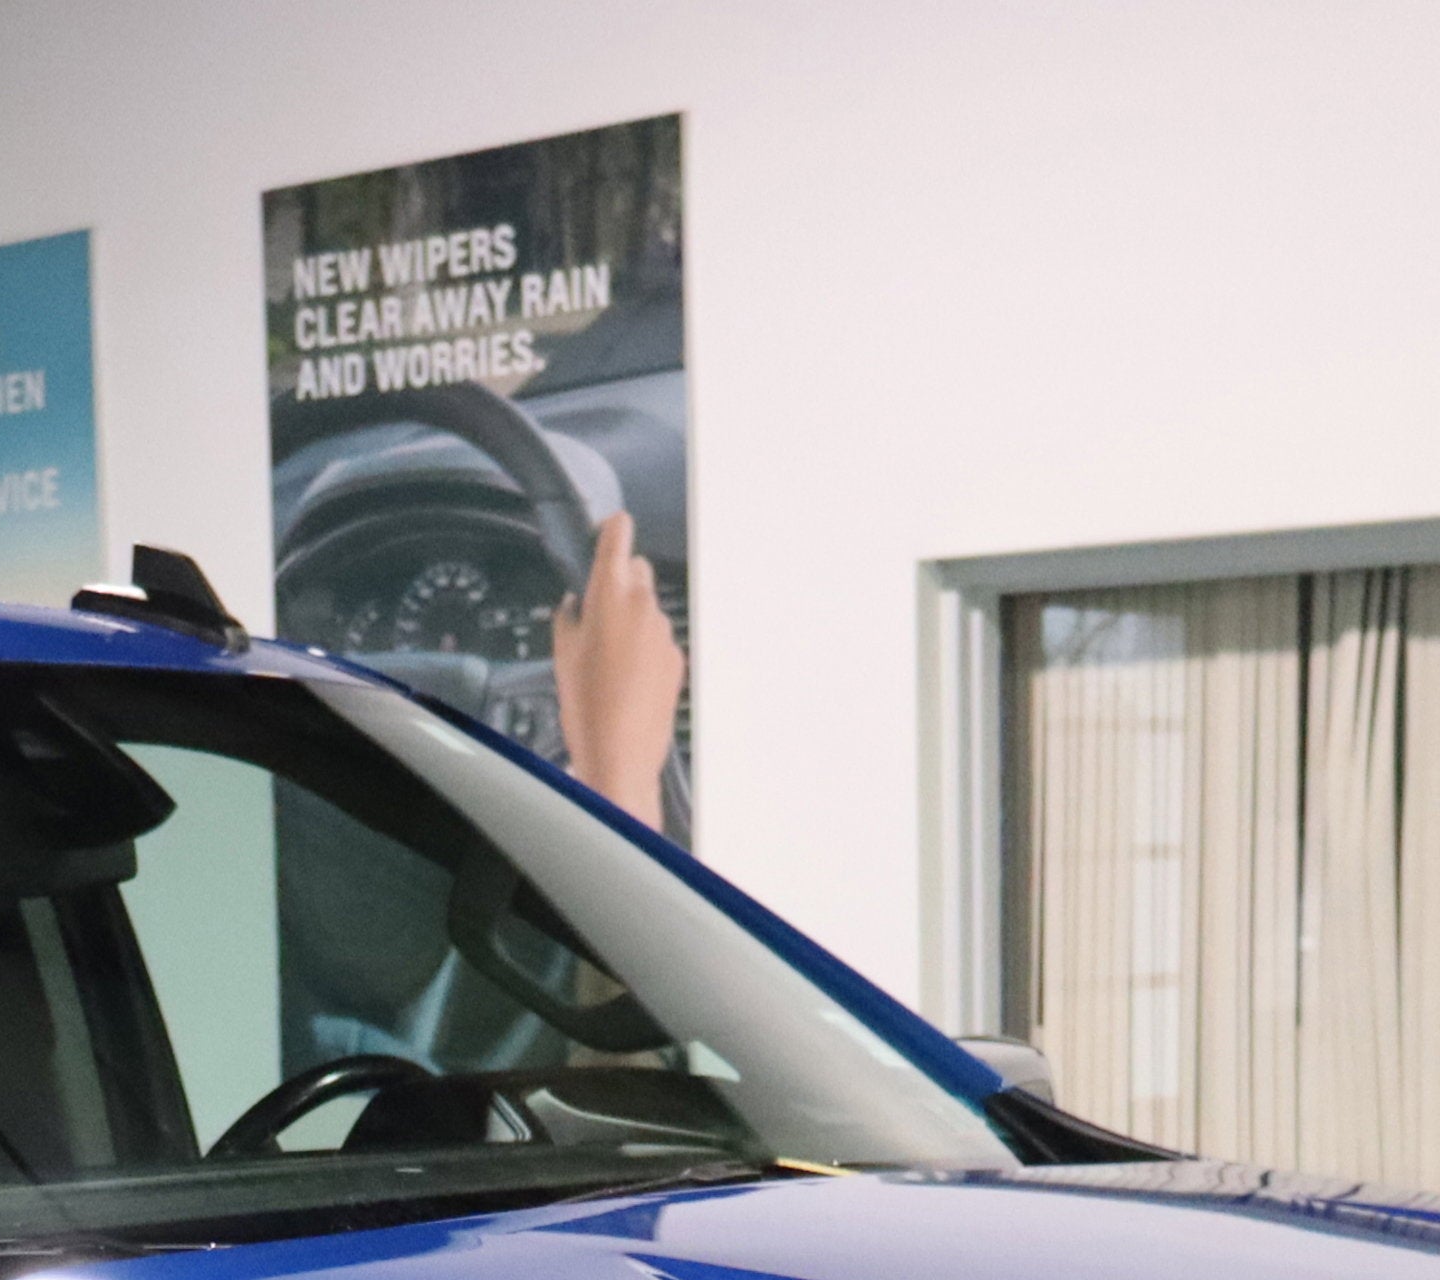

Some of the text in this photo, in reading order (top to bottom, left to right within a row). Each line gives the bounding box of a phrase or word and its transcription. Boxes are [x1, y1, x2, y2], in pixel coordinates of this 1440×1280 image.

[293, 223, 517, 299] NEW WIPERS
[294, 262, 610, 350] CLEAR AWAY RAIN
[296, 330, 547, 401] AND WORRIES.
